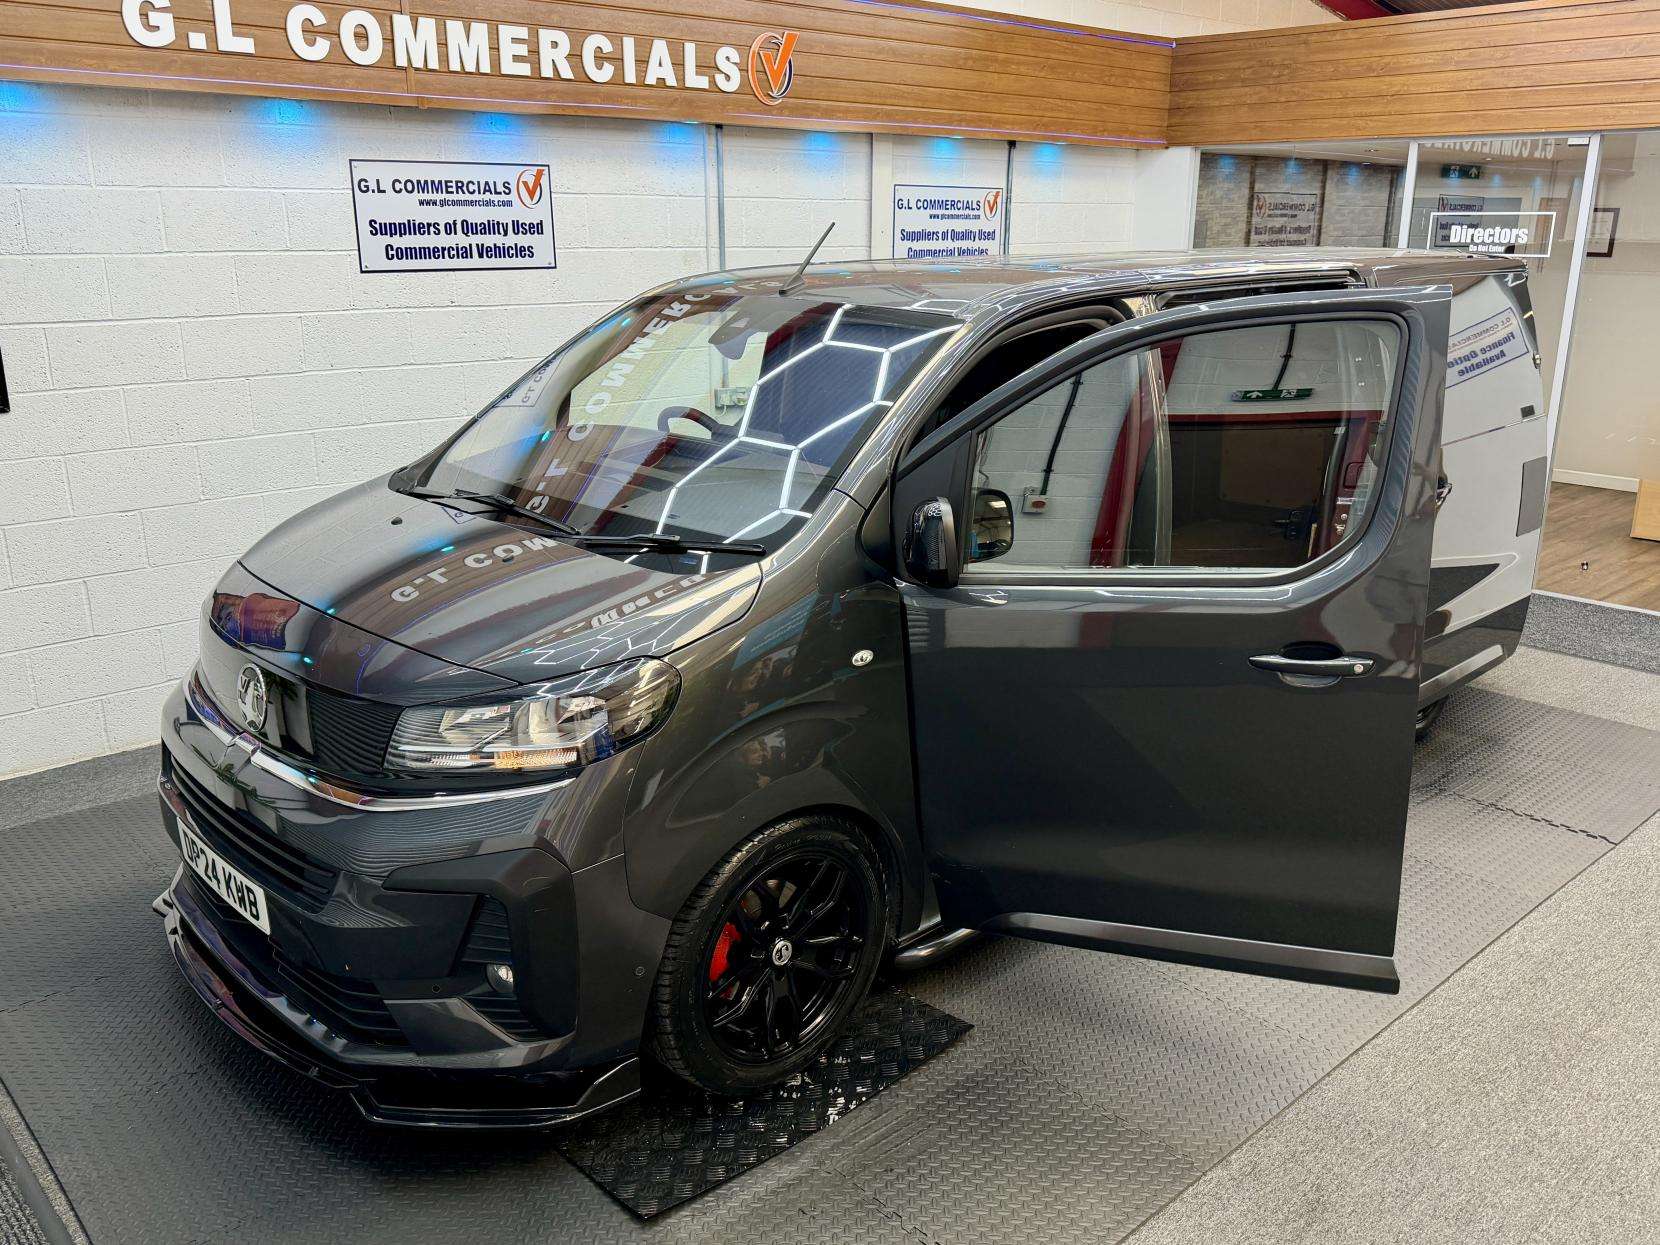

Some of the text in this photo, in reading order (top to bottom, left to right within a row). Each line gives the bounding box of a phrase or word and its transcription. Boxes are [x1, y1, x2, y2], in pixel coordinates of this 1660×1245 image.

[121, 0, 741, 93] G.L COMMERCIALS
[357, 178, 512, 196] G.L COMMERCIALS
[418, 198, 513, 208] www.glcommercials.com
[897, 198, 981, 212] G.L COMMERCIALS
[369, 218, 544, 238] Suppliers of Quality Used
[900, 228, 996, 243] Suppliers of Quality Used
[1449, 225, 1528, 244] Directors
[384, 243, 535, 260] Commercial Vehicles
[907, 246, 989, 259] Commercial Vehicles
